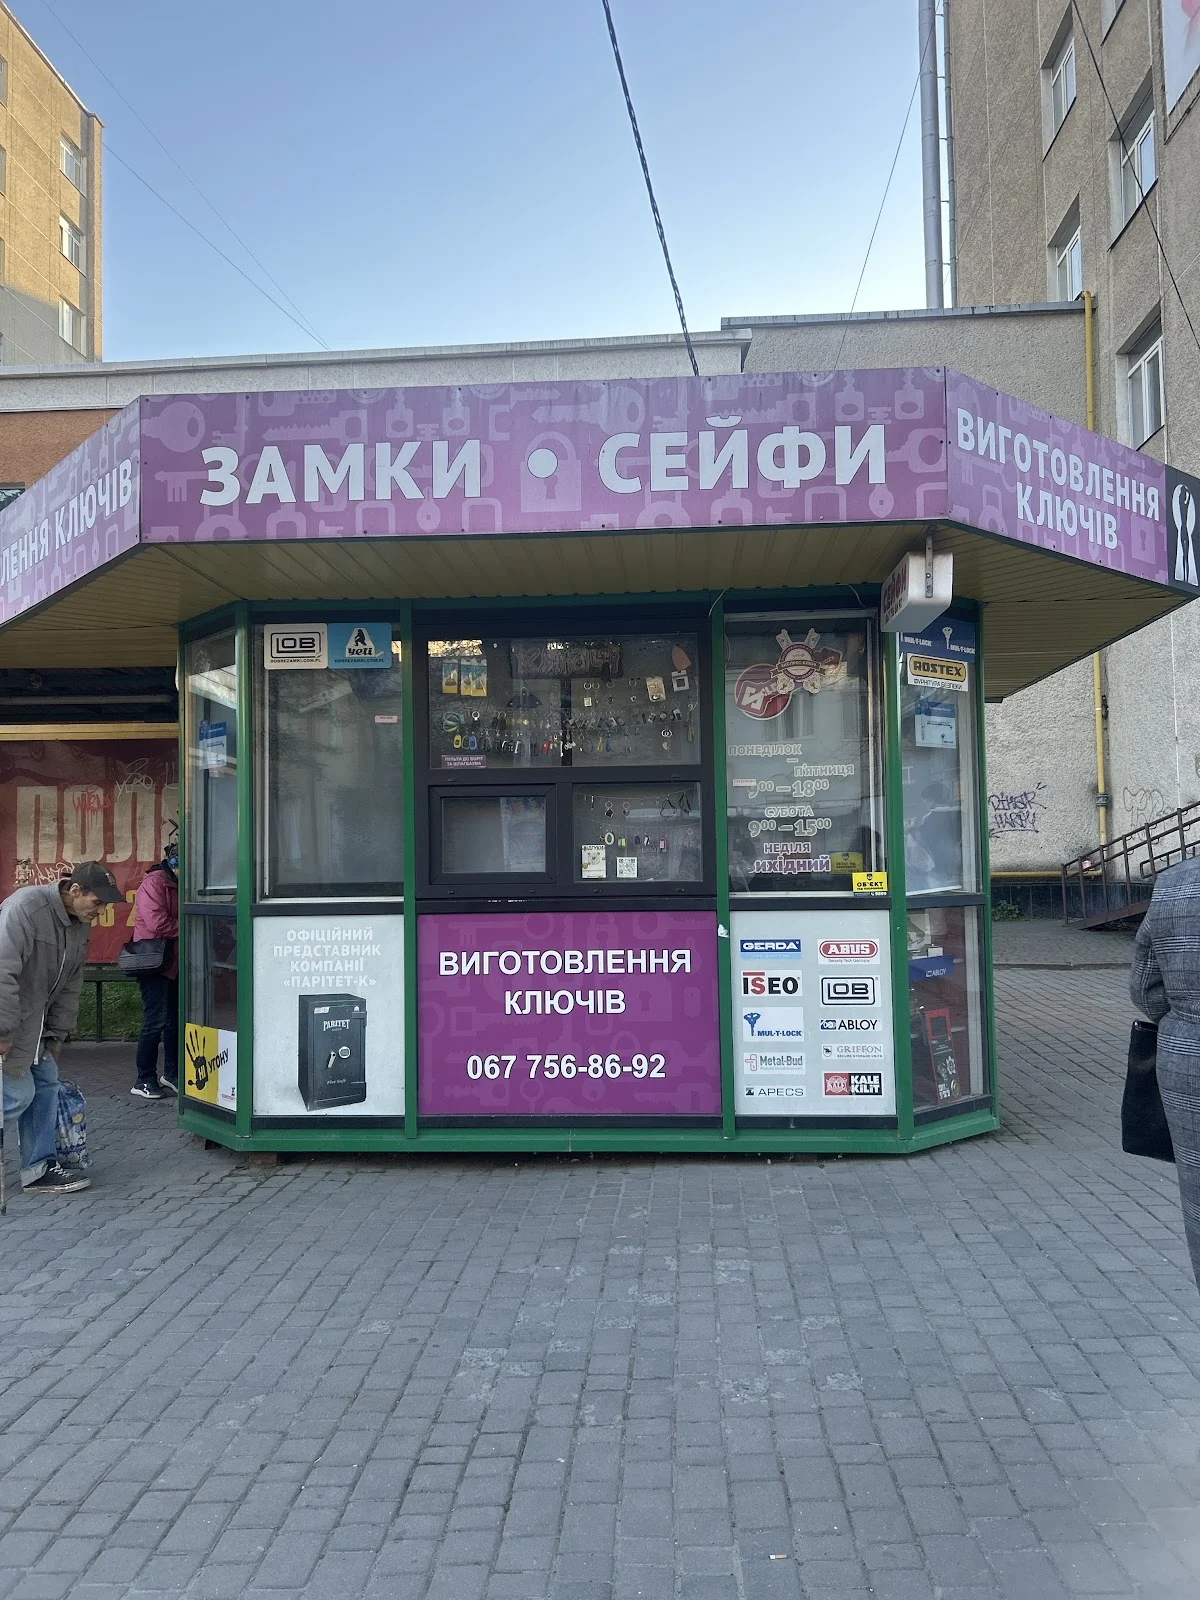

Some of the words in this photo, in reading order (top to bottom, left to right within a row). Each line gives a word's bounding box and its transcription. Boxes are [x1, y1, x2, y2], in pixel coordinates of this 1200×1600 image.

[199, 438, 482, 506] ЗАМКИ
[598, 415, 886, 495] СЕЙФИ
[956, 407, 1161, 521] ВИГОТОВЛЕННЯ
[54, 458, 133, 551] КЛЮЧІВ
[1016, 481, 1119, 550] КЛЮЧІВ
[913, 660, 962, 677] ROSTEX
[727, 744, 802, 757] ПОНЕДІЛОК
[794, 763, 854, 777] П'ЯТНИЦЯ
[764, 806, 814, 818] СУБОТА
[763, 842, 811, 855] НЕДІЛЯ
[286, 927, 373, 942] ОФІЦІЙНИЙ
[273, 943, 382, 958] ПРЕДСТАВНИК
[742, 941, 799, 950] GERDA
[827, 944, 871, 955] ABUS
[290, 958, 365, 973] КОМПАНІЇ
[438, 949, 692, 976] ВИГОТОВЛЕННЯ
[283, 974, 377, 988] «ПАРІТЕТ-К»
[742, 976, 799, 995] ISEO
[827, 982, 870, 1000] LOB
[504, 989, 627, 1015] КЛЮЧІВ
[323, 1019, 351, 1031] PARITET
[837, 1019, 878, 1031] ABLOY
[836, 1045, 882, 1054] GRIFFON
[208, 1047, 229, 1073] УГОНУ
[466, 1054, 517, 1080] 067
[526, 1053, 667, 1079] 756-86-92
[760, 1055, 803, 1066] Metal-Bud
[850, 1075, 880, 1084] KALE
[758, 1087, 804, 1097] APECS
